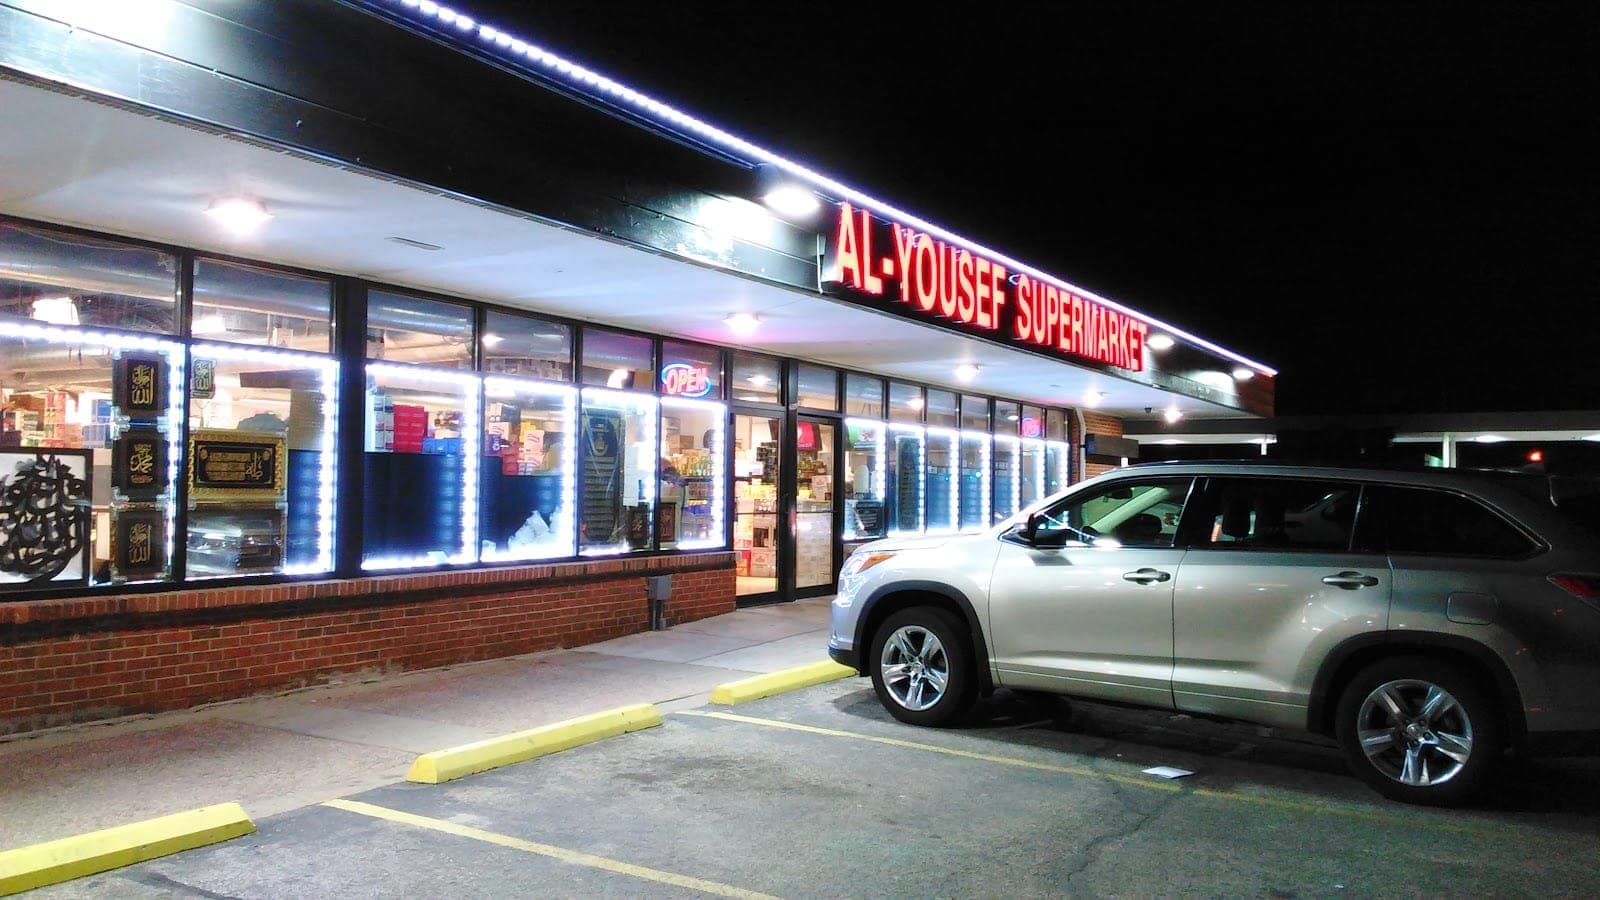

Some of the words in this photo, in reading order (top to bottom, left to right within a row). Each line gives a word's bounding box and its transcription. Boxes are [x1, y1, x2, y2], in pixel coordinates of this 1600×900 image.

[835, 201, 1007, 330] AL-YOUSEF
[1015, 273, 1148, 373] SUPERMARKET
[666, 367, 708, 395] OPEN
